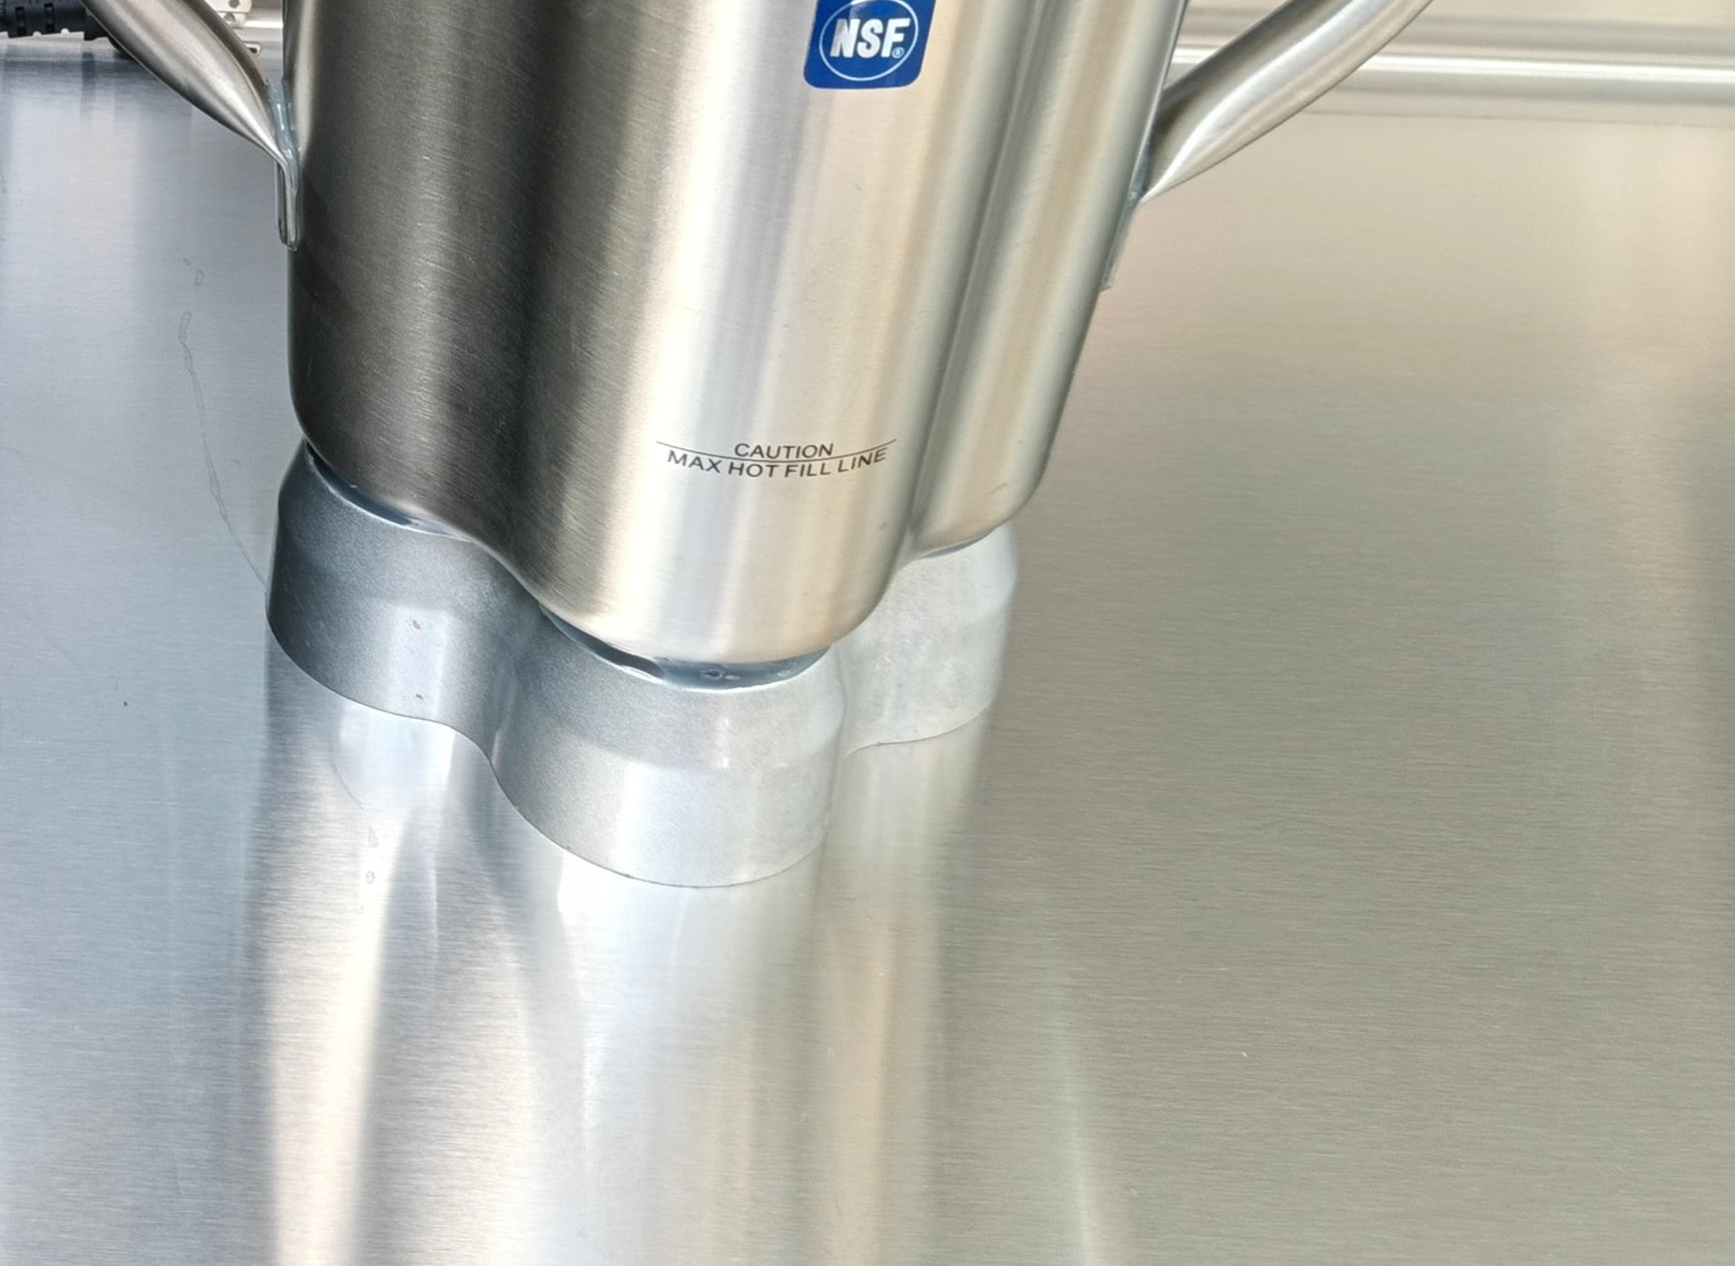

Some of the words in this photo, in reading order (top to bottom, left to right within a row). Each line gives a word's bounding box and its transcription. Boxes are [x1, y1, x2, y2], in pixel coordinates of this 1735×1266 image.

[829, 18, 911, 58] NSF
[667, 450, 722, 473] MAX
[728, 461, 779, 477] HOT
[785, 463, 832, 477] FILL
[838, 446, 888, 472] LINE
[734, 443, 834, 460] CAUTION
